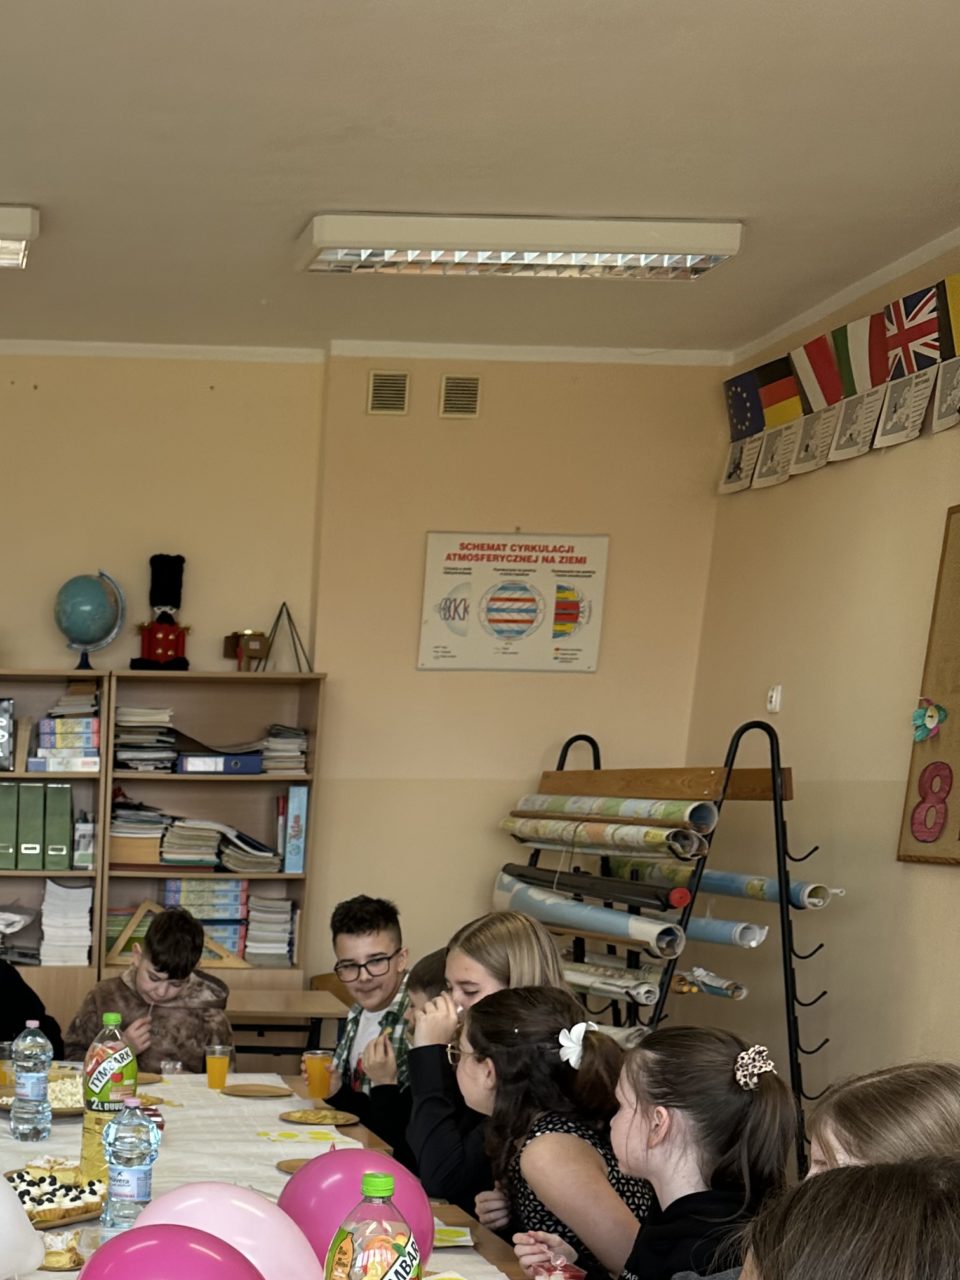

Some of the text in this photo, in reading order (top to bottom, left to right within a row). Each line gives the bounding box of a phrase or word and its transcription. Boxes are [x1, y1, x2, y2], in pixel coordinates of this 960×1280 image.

[459, 542, 575, 553] SCHEMAT CYRKULACJI
[445, 553, 587, 564] ATMOSFERYCZNEJ NA ZIEMI
